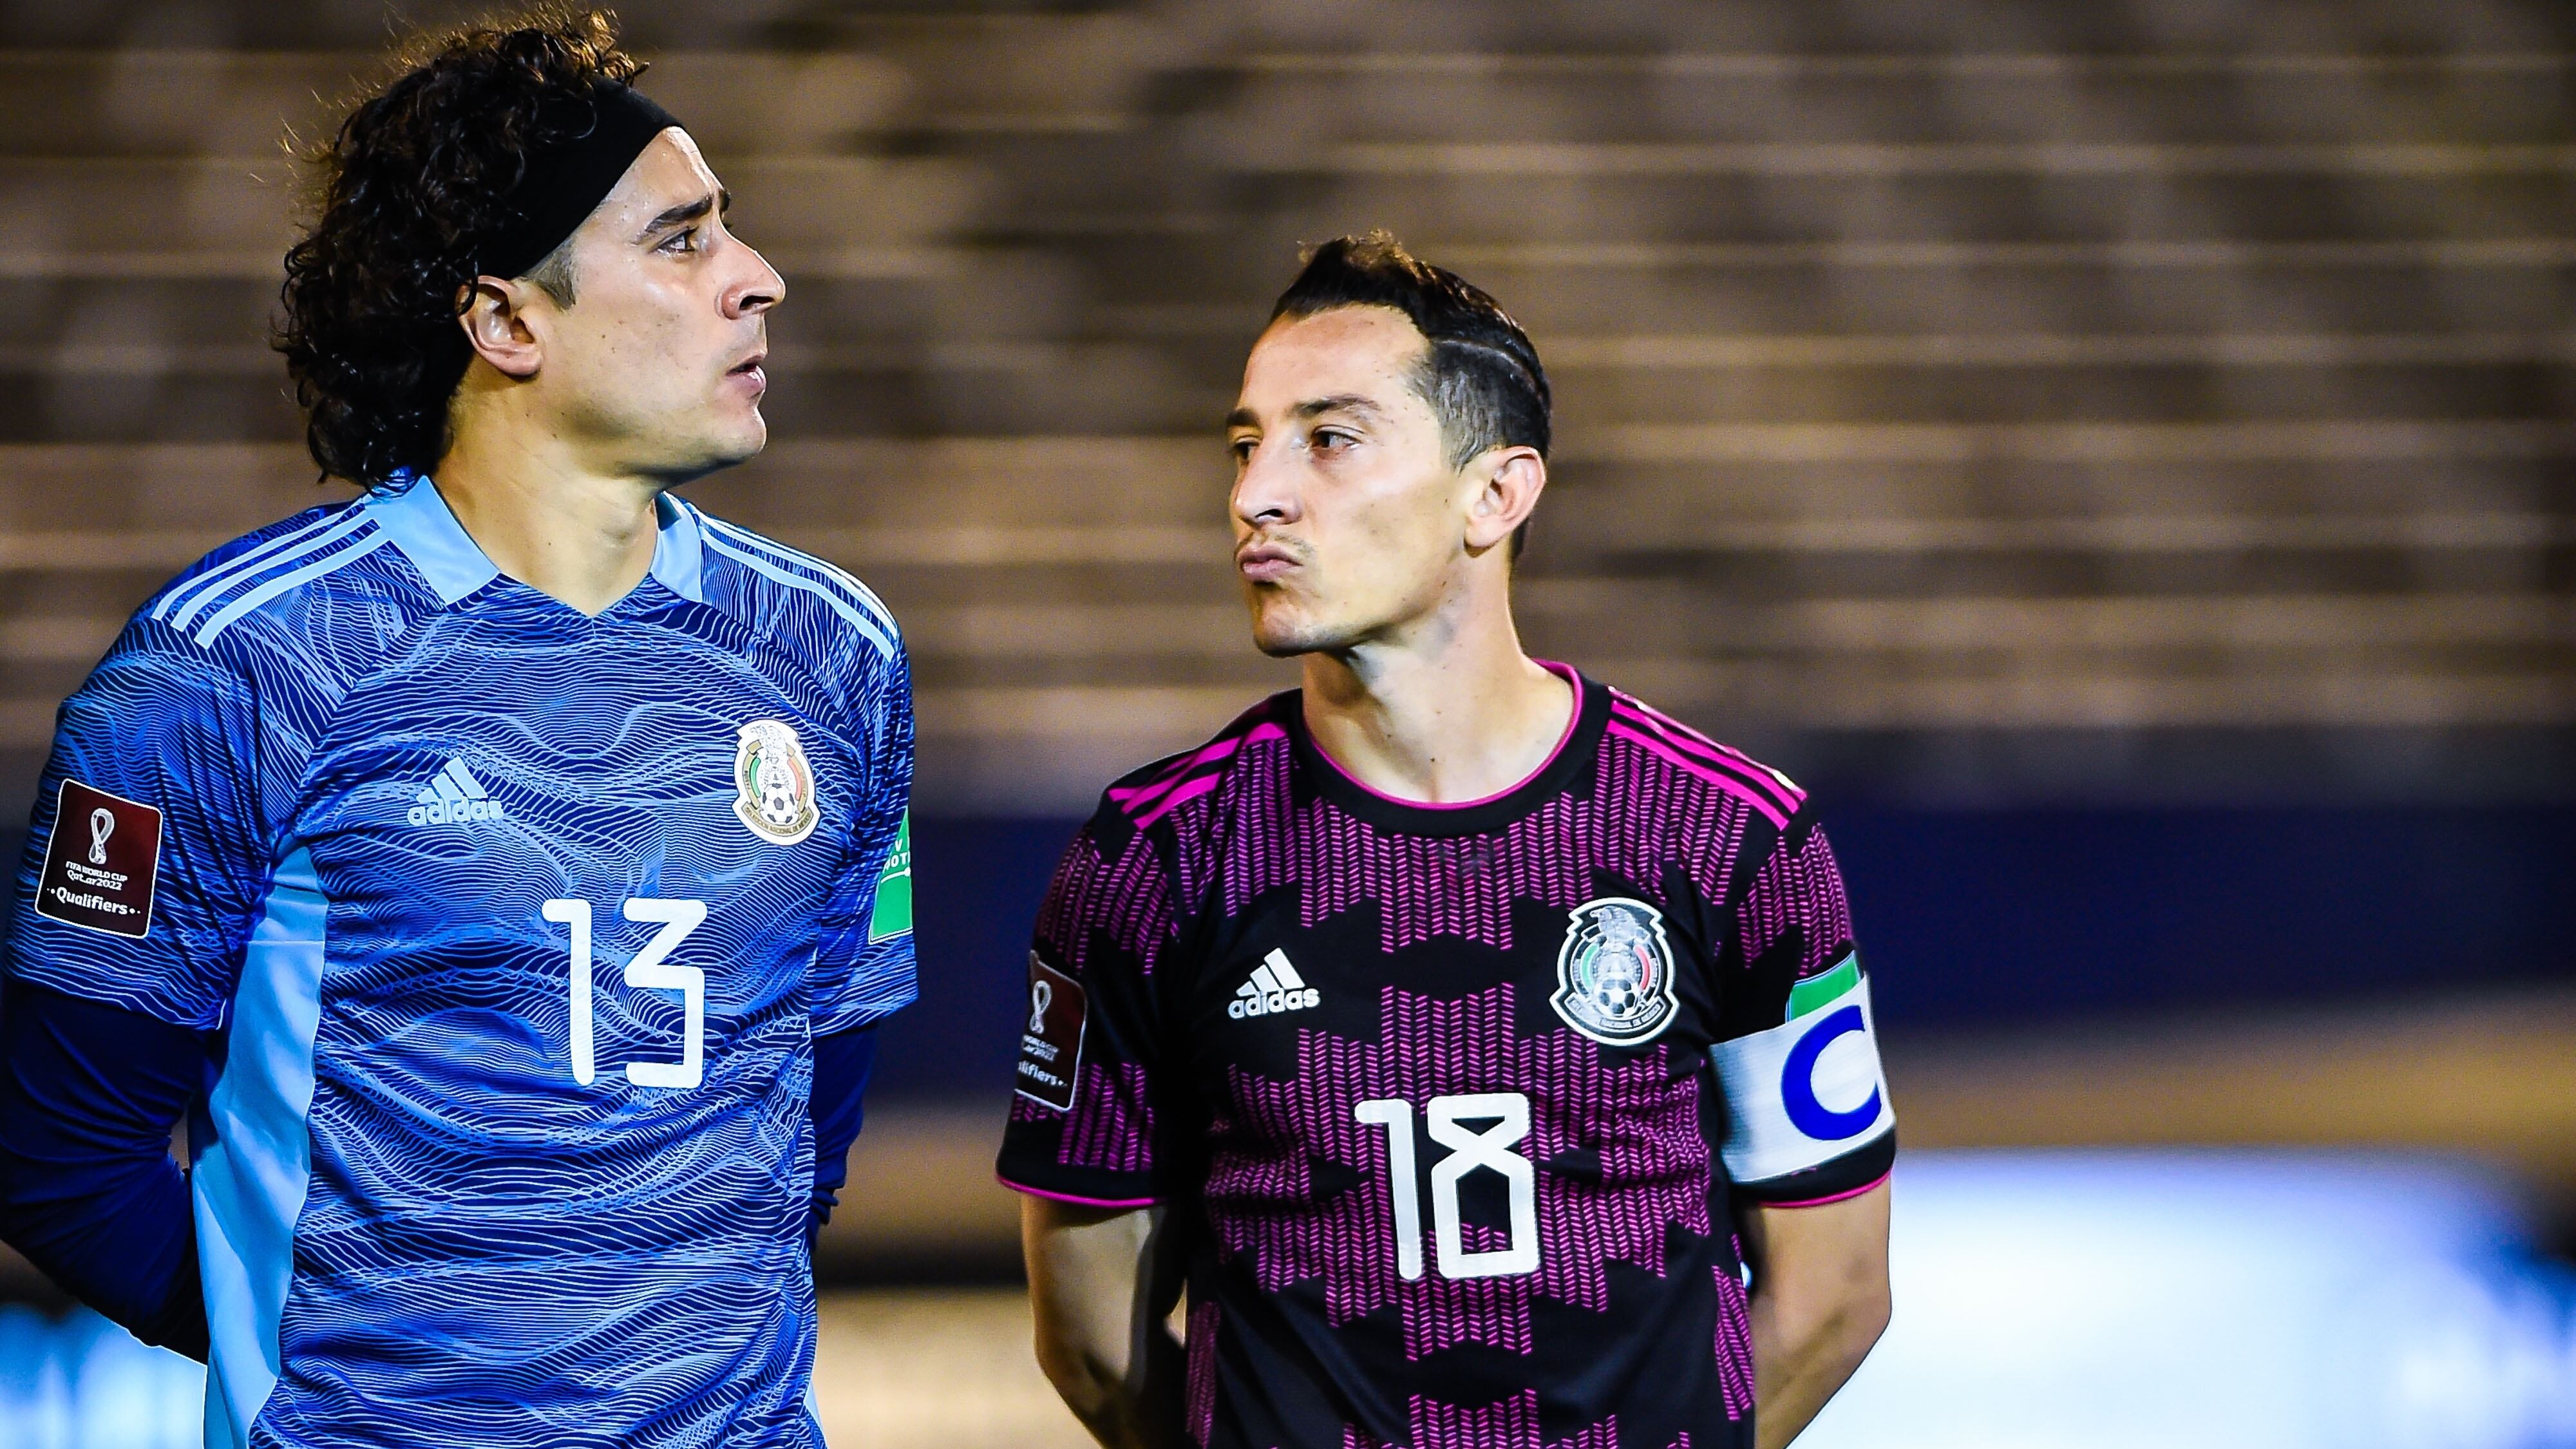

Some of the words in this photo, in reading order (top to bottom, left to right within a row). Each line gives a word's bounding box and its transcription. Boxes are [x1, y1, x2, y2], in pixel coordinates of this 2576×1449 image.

[407, 798, 504, 826] adidas
[66, 861, 81, 872] FIFA
[82, 865, 110, 878] WORLD
[111, 873, 128, 882] CUP
[56, 887, 128, 914] Qualifiers
[542, 898, 708, 1088] 13
[1227, 987, 1320, 1019] adidas
[1781, 1005, 1882, 1141] C
[1354, 1092, 1540, 1280] 18
